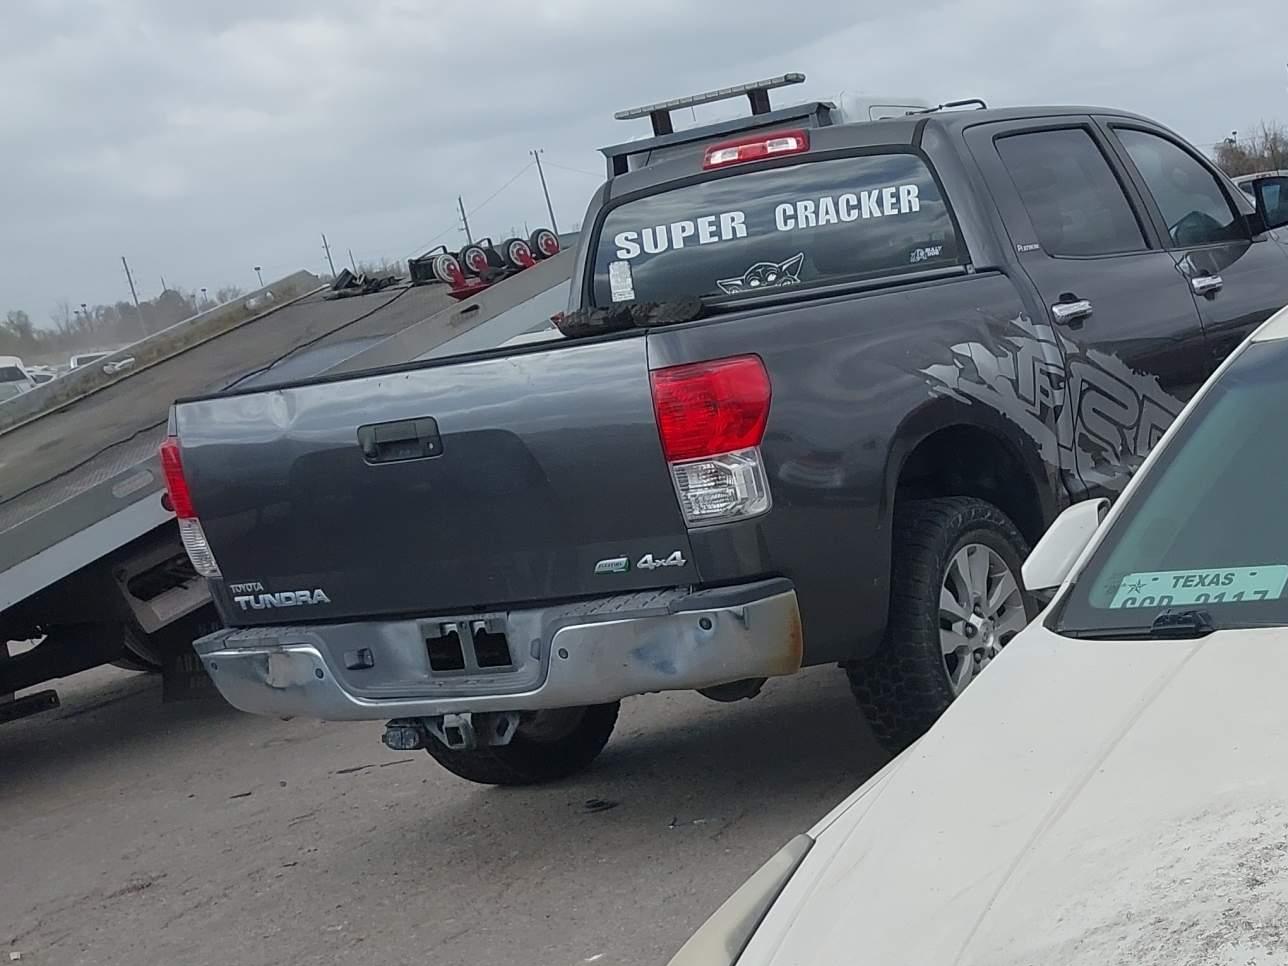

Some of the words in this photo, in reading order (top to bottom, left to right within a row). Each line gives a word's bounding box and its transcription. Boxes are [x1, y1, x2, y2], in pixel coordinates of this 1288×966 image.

[614, 210, 748, 260] SUPER
[774, 184, 921, 232] CRACKER
[636, 550, 688, 570] 4x4
[229, 582, 264, 594] TOYOTA
[1171, 572, 1236, 589] TEXAS
[234, 588, 332, 611] TUNDRA
